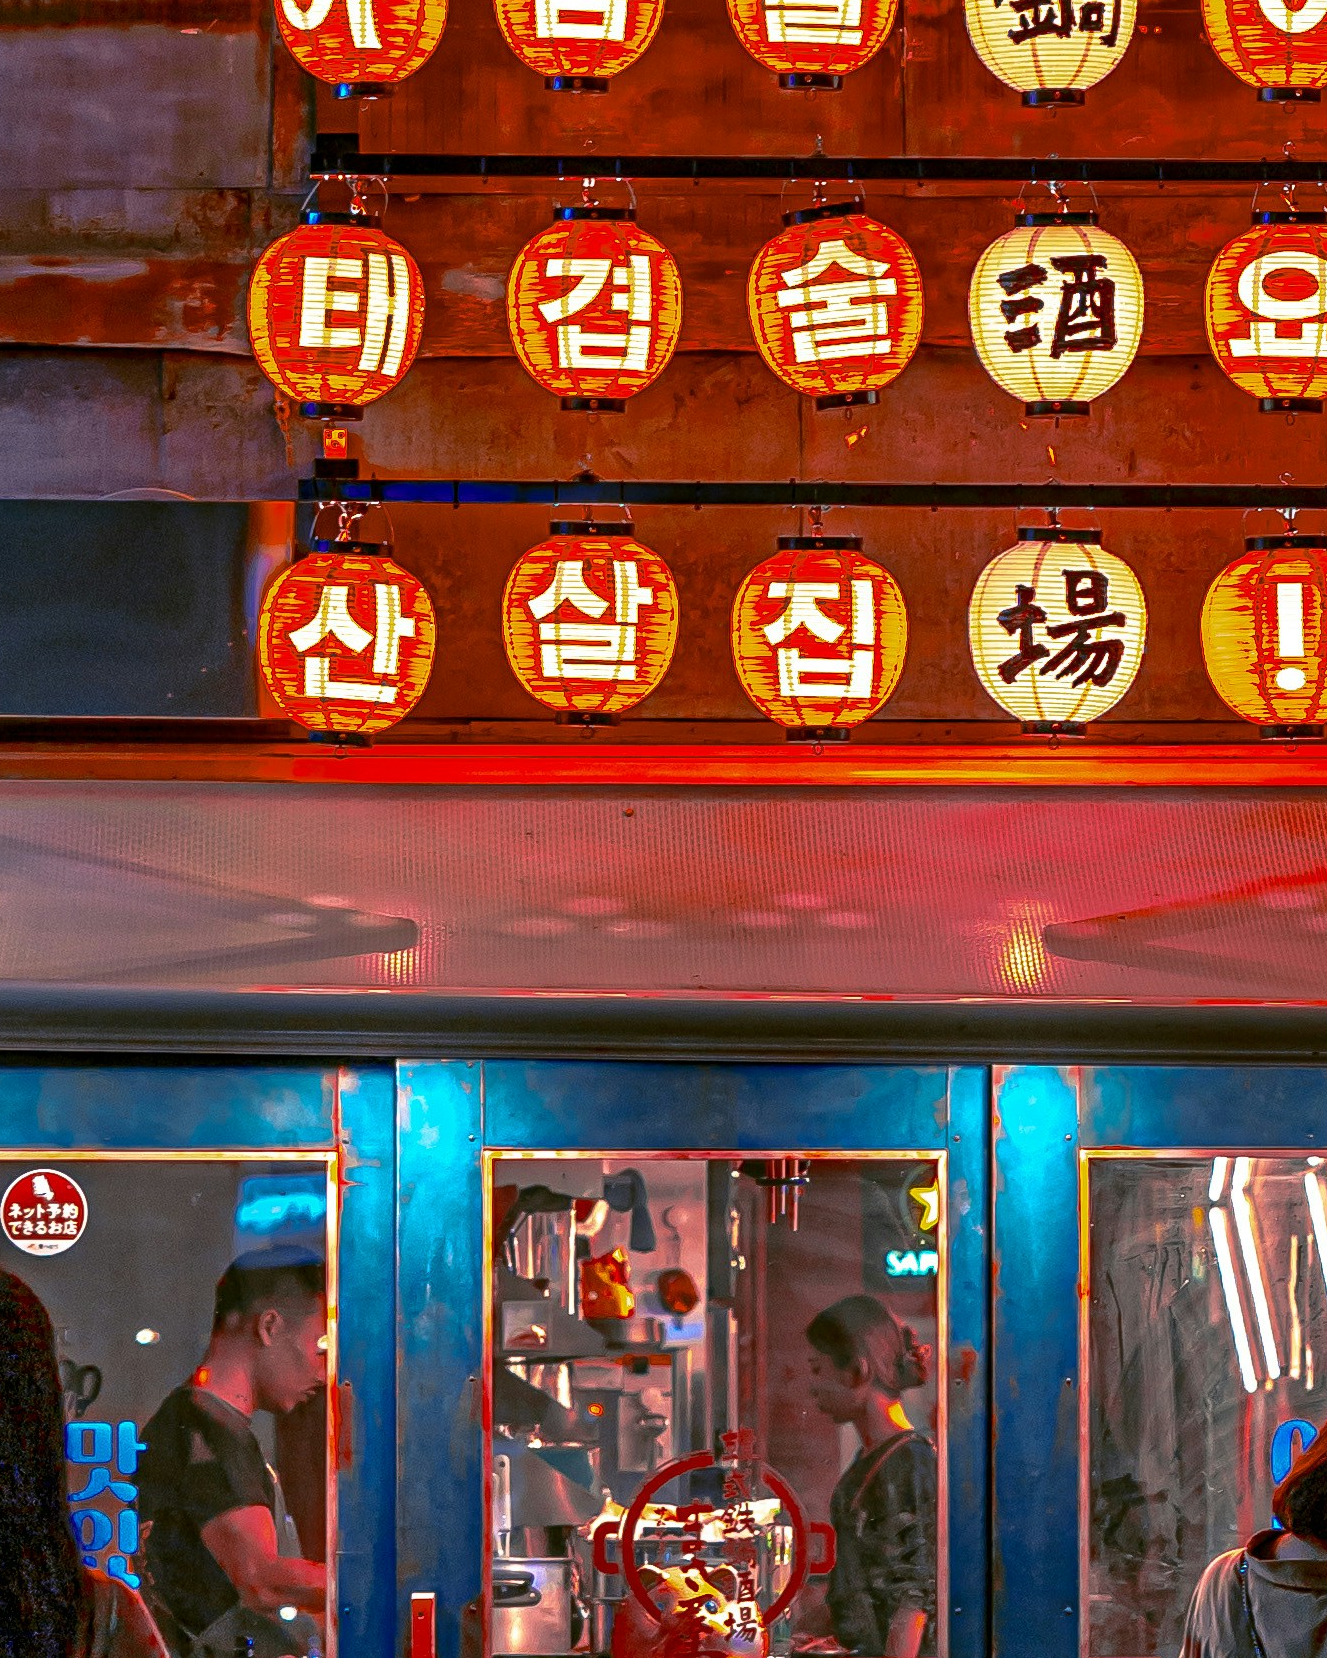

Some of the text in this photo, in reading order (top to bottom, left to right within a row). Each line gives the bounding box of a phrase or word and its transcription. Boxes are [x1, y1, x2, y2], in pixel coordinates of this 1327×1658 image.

[299, 254, 408, 375] 태
[538, 255, 650, 370] 겁
[778, 240, 896, 362] 술
[997, 255, 1117, 359] 酒
[289, 584, 414, 703] 산
[528, 561, 652, 680] 살
[764, 580, 874, 698] 집
[997, 570, 1125, 688] 場
[7, 1203, 79, 1220] ネット予約
[7, 1220, 78, 1236] できるお店
